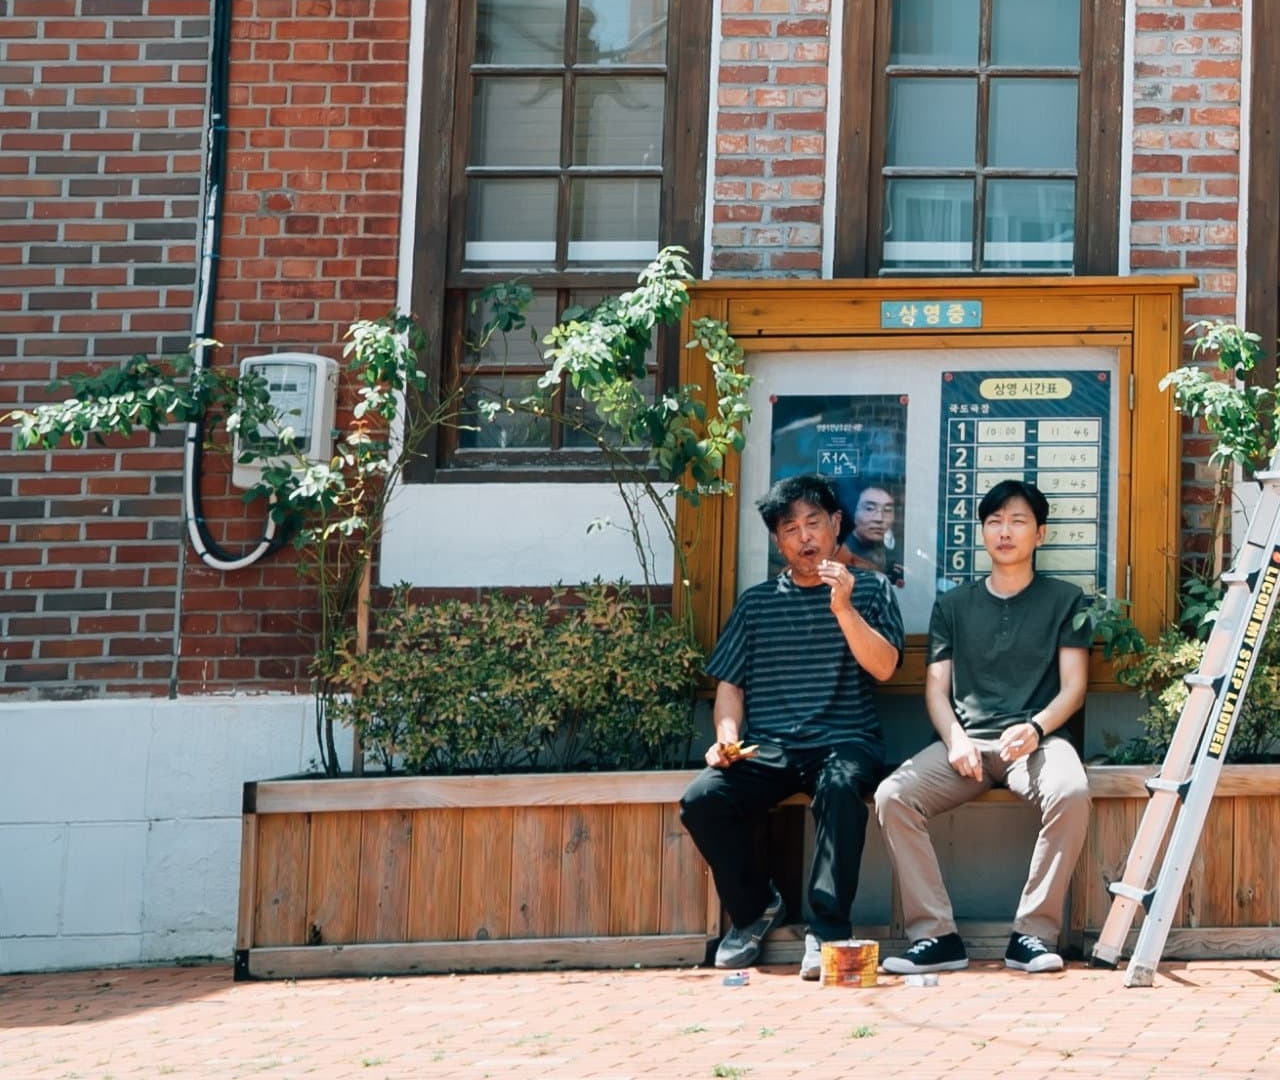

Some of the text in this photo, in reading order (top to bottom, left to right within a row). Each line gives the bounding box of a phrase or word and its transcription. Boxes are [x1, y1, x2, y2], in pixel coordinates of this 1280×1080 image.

[899, 303, 965, 325] 상영중
[994, 381, 1058, 396] 상영 시간표
[957, 422, 966, 441] 1
[955, 448, 968, 468] 2
[954, 473, 967, 493] 3
[953, 499, 968, 519] 4
[953, 524, 966, 545] 5
[952, 550, 966, 570] 6
[1209, 565, 1280, 756] LICOM MY STEP LADDER
